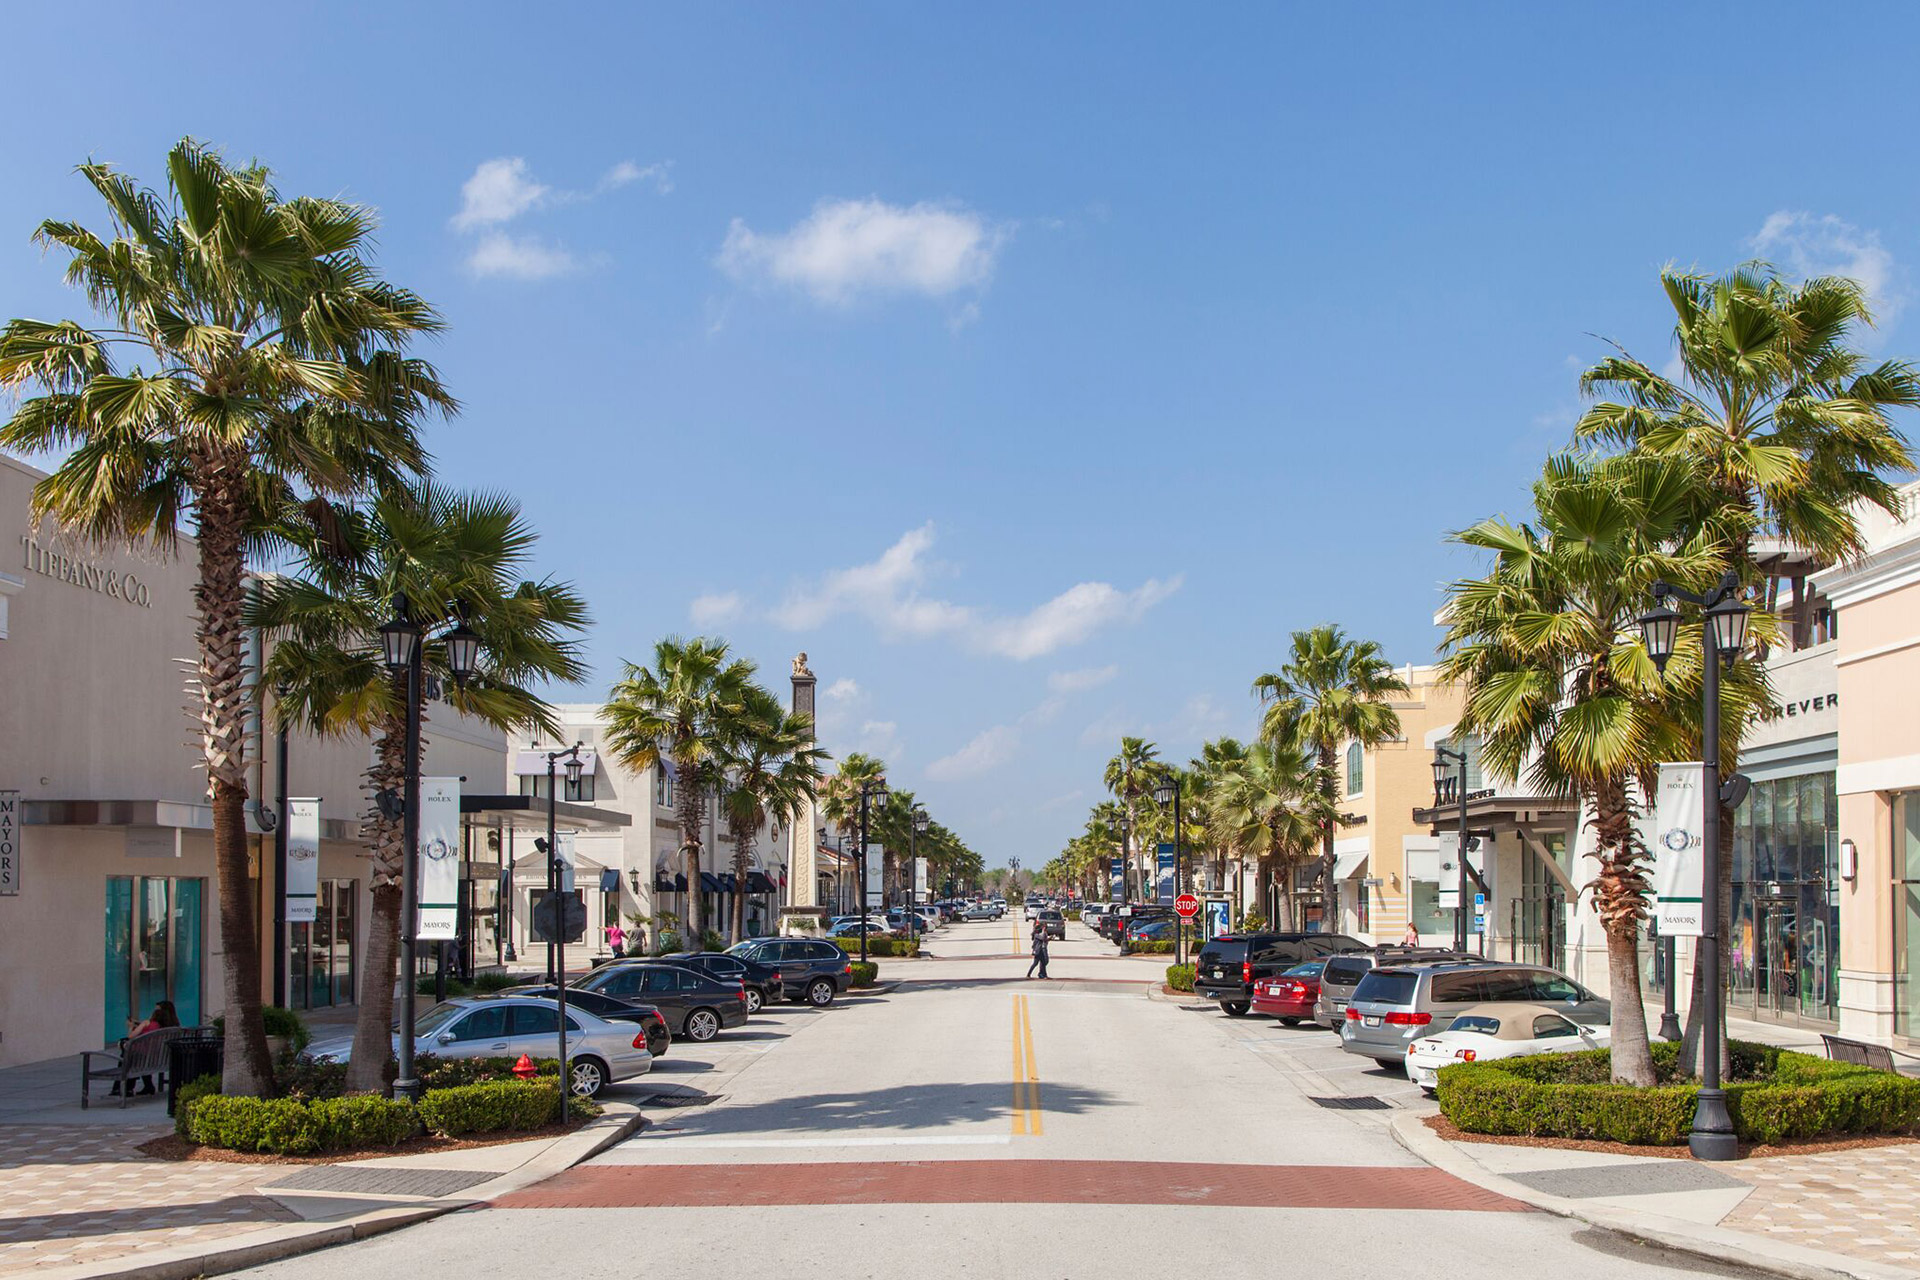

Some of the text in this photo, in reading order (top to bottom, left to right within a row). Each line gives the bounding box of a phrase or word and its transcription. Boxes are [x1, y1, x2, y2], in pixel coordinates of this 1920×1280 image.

[0, 800, 14, 884] MAYORS
[1176, 900, 1197, 910] STOP
[1664, 916, 1696, 925] MAYORS
[423, 921, 451, 930] MAYORS
